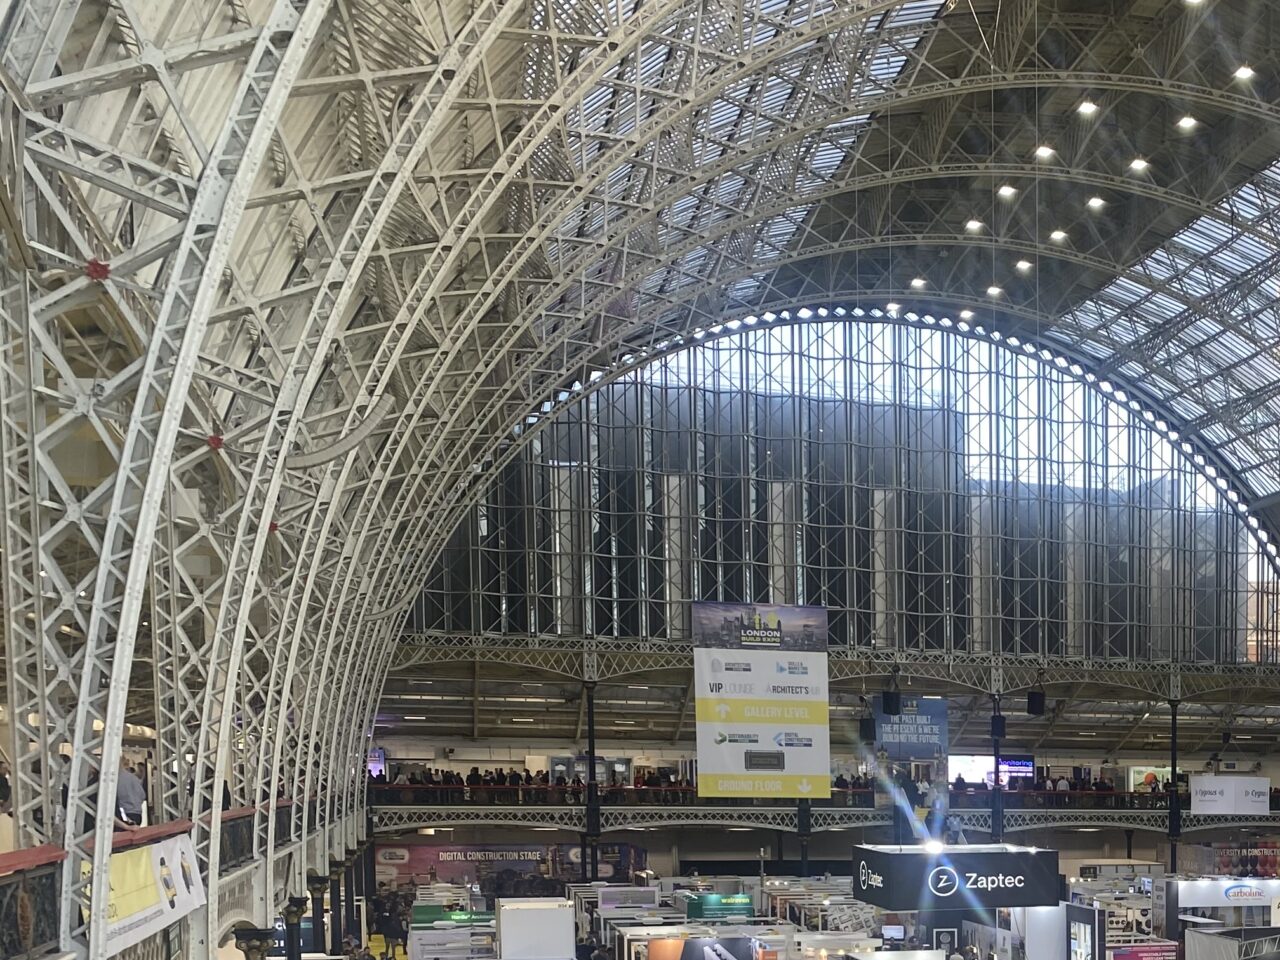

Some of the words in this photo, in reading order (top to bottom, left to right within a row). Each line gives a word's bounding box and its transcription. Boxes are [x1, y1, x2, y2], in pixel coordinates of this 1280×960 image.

[741, 629, 780, 637] LONDON
[708, 682, 723, 693] VIP
[744, 706, 782, 718] GALLERY
[784, 707, 810, 719] LEVEL
[999, 758, 1033, 768] onitoring
[439, 851, 466, 861] DIGITAL
[466, 851, 519, 861] CONSTRUCTION
[519, 851, 541, 861] STAGE
[867, 869, 884, 888] Zaptec
[965, 873, 1025, 891] Zaptec
